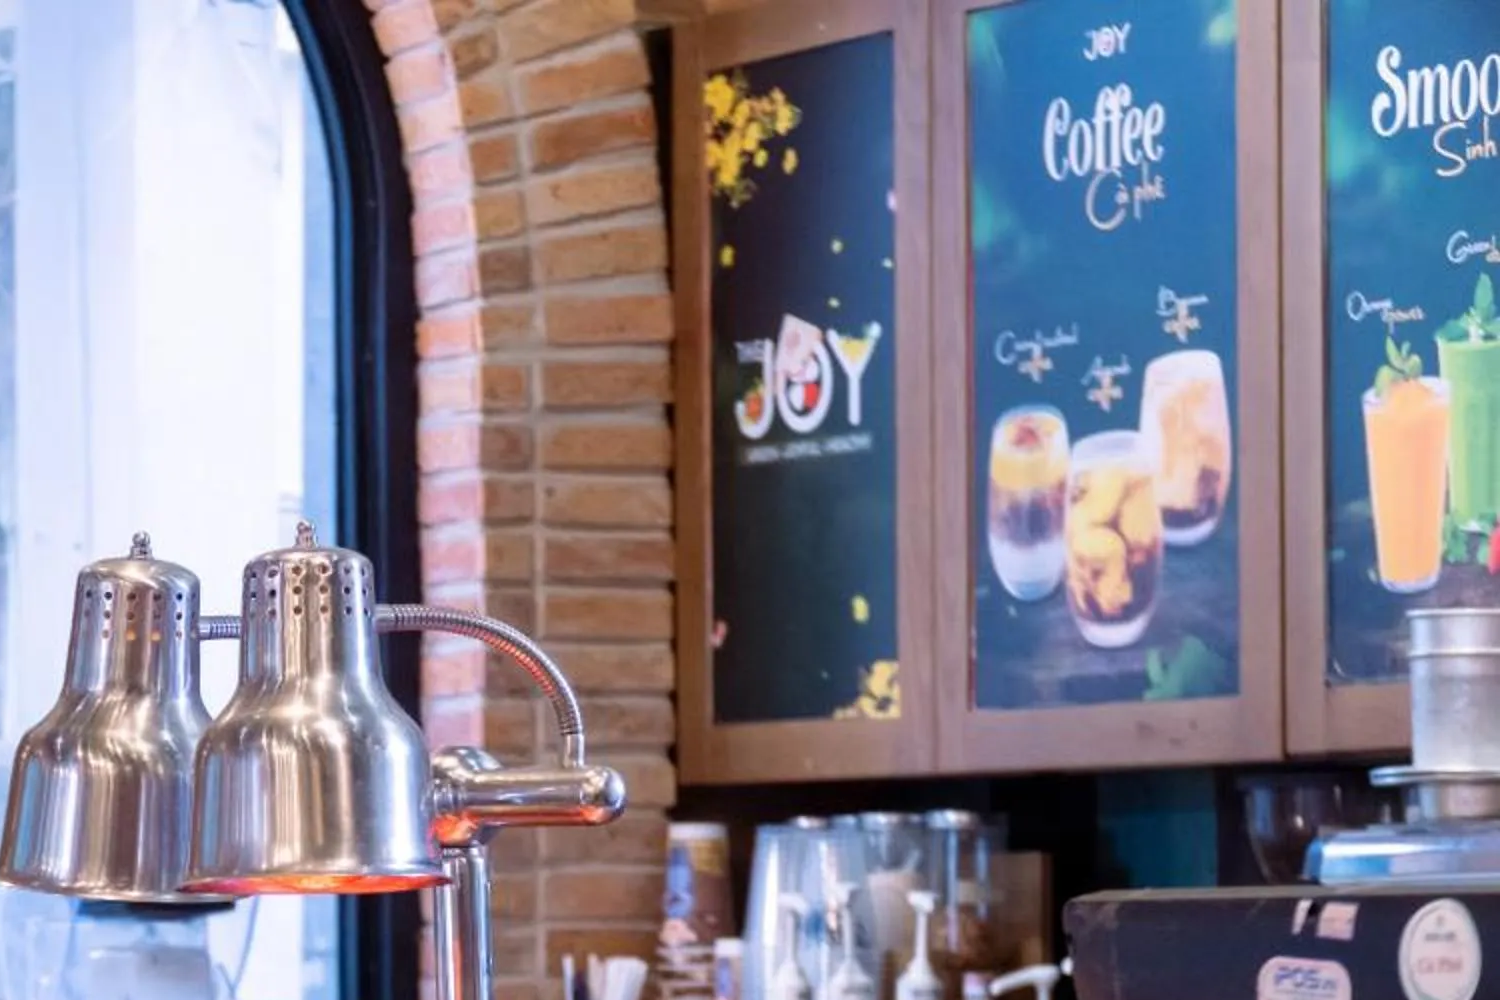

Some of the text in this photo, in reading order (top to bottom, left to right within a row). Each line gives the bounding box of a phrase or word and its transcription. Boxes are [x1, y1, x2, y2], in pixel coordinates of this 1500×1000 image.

[1083, 22, 1131, 61] JOY
[1043, 82, 1166, 182] Coffee
[1433, 121, 1497, 176] Sinh
[734, 318, 882, 440] JOY
